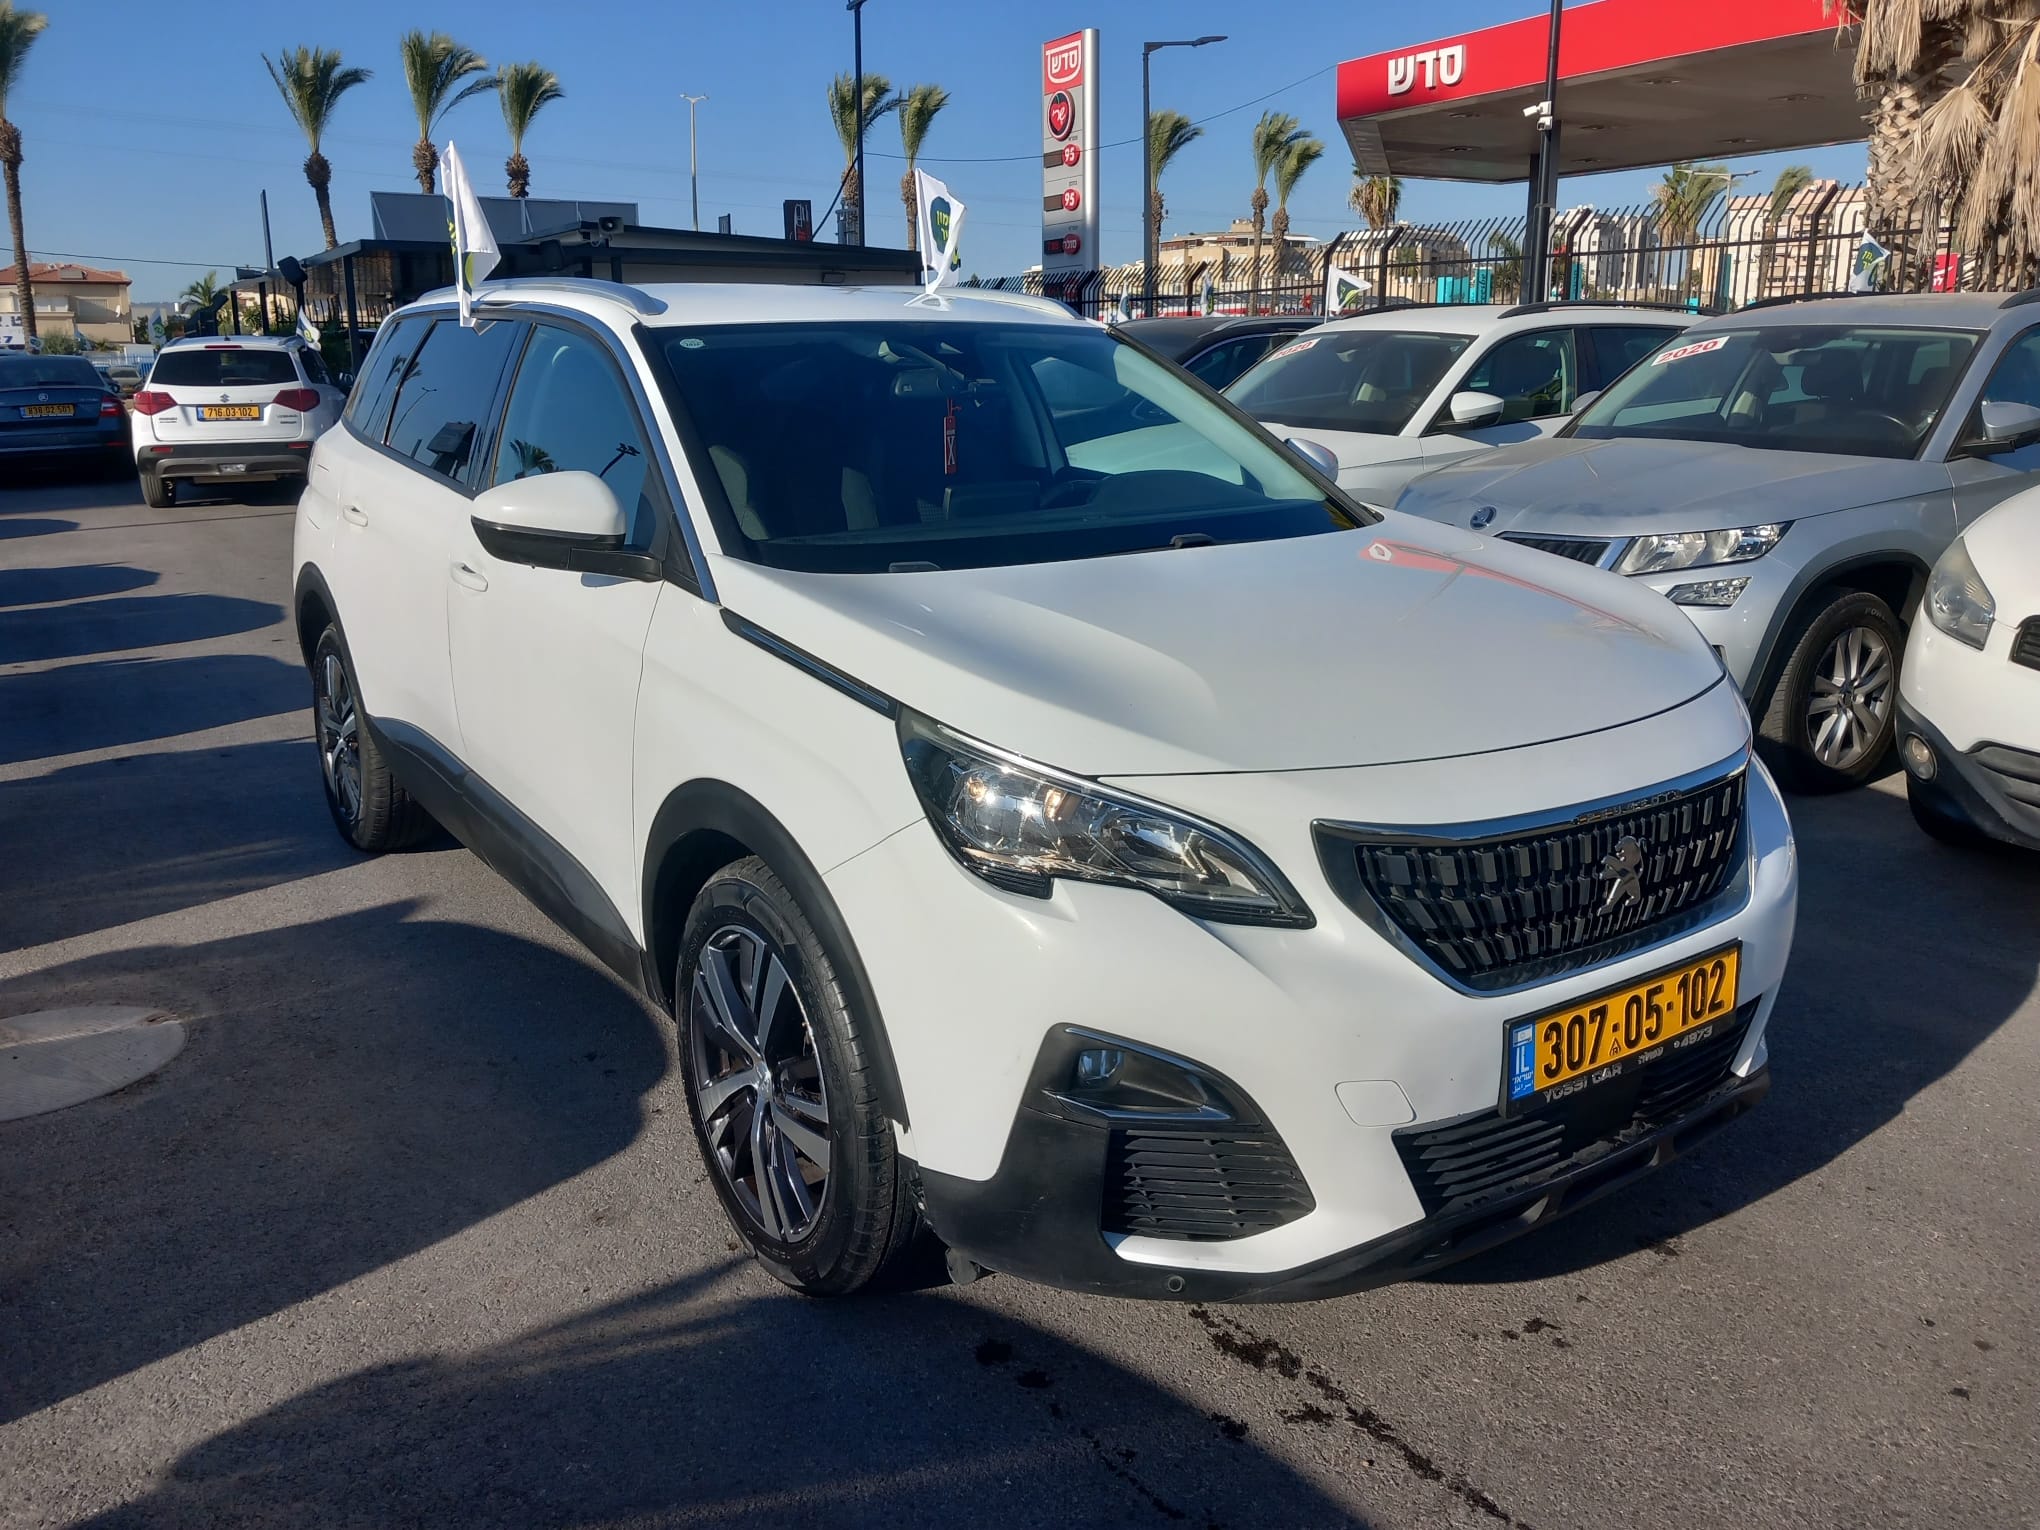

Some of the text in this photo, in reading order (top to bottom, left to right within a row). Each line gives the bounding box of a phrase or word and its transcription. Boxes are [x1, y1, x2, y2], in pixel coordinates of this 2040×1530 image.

[1051, 49, 1078, 74] סדש
[1387, 44, 1466, 96] סדש
[1064, 146, 1075, 162] 95
[1064, 192, 1075, 207] 95
[1659, 340, 1719, 361] 2020
[1516, 1045, 1530, 1075] IL
[1543, 1062, 1623, 1104] YOSSI CAR
